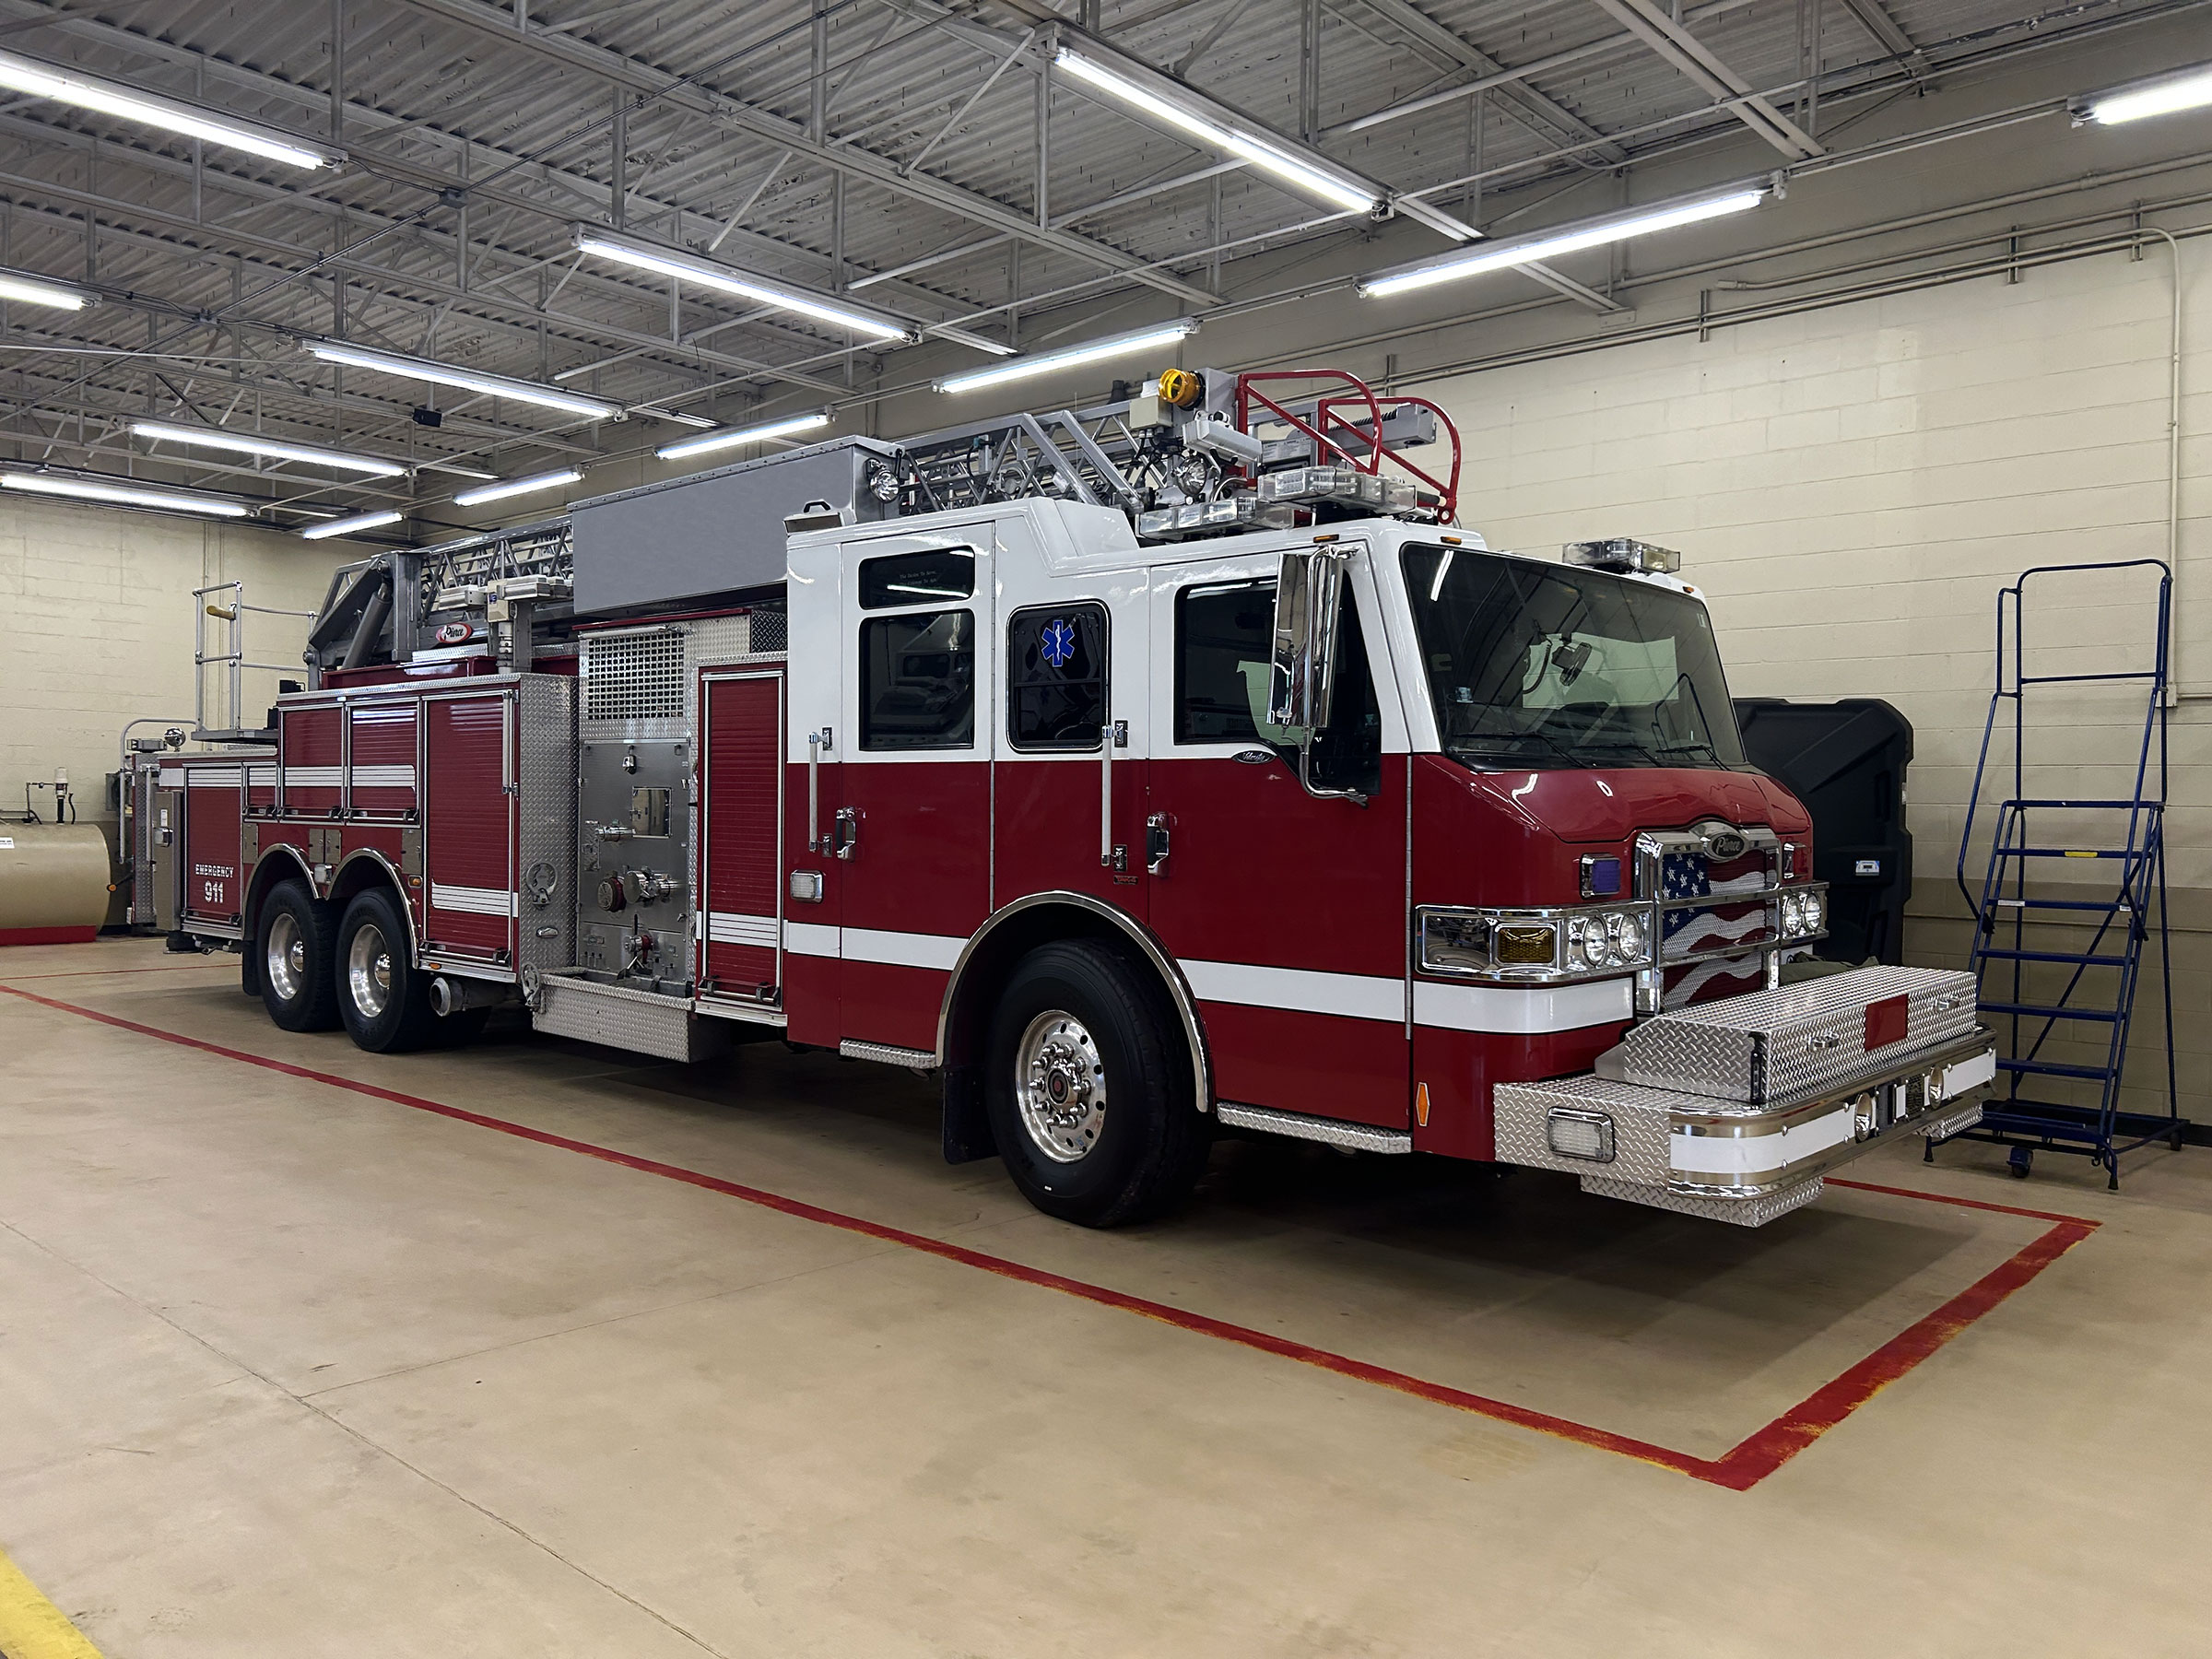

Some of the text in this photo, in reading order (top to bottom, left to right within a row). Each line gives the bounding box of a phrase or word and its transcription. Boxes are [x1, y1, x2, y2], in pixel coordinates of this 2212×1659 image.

[444, 627, 465, 640] Pierce
[1715, 837, 1741, 855] Pierce
[195, 864, 234, 878] EMERGENCY
[205, 880, 224, 903] 911
